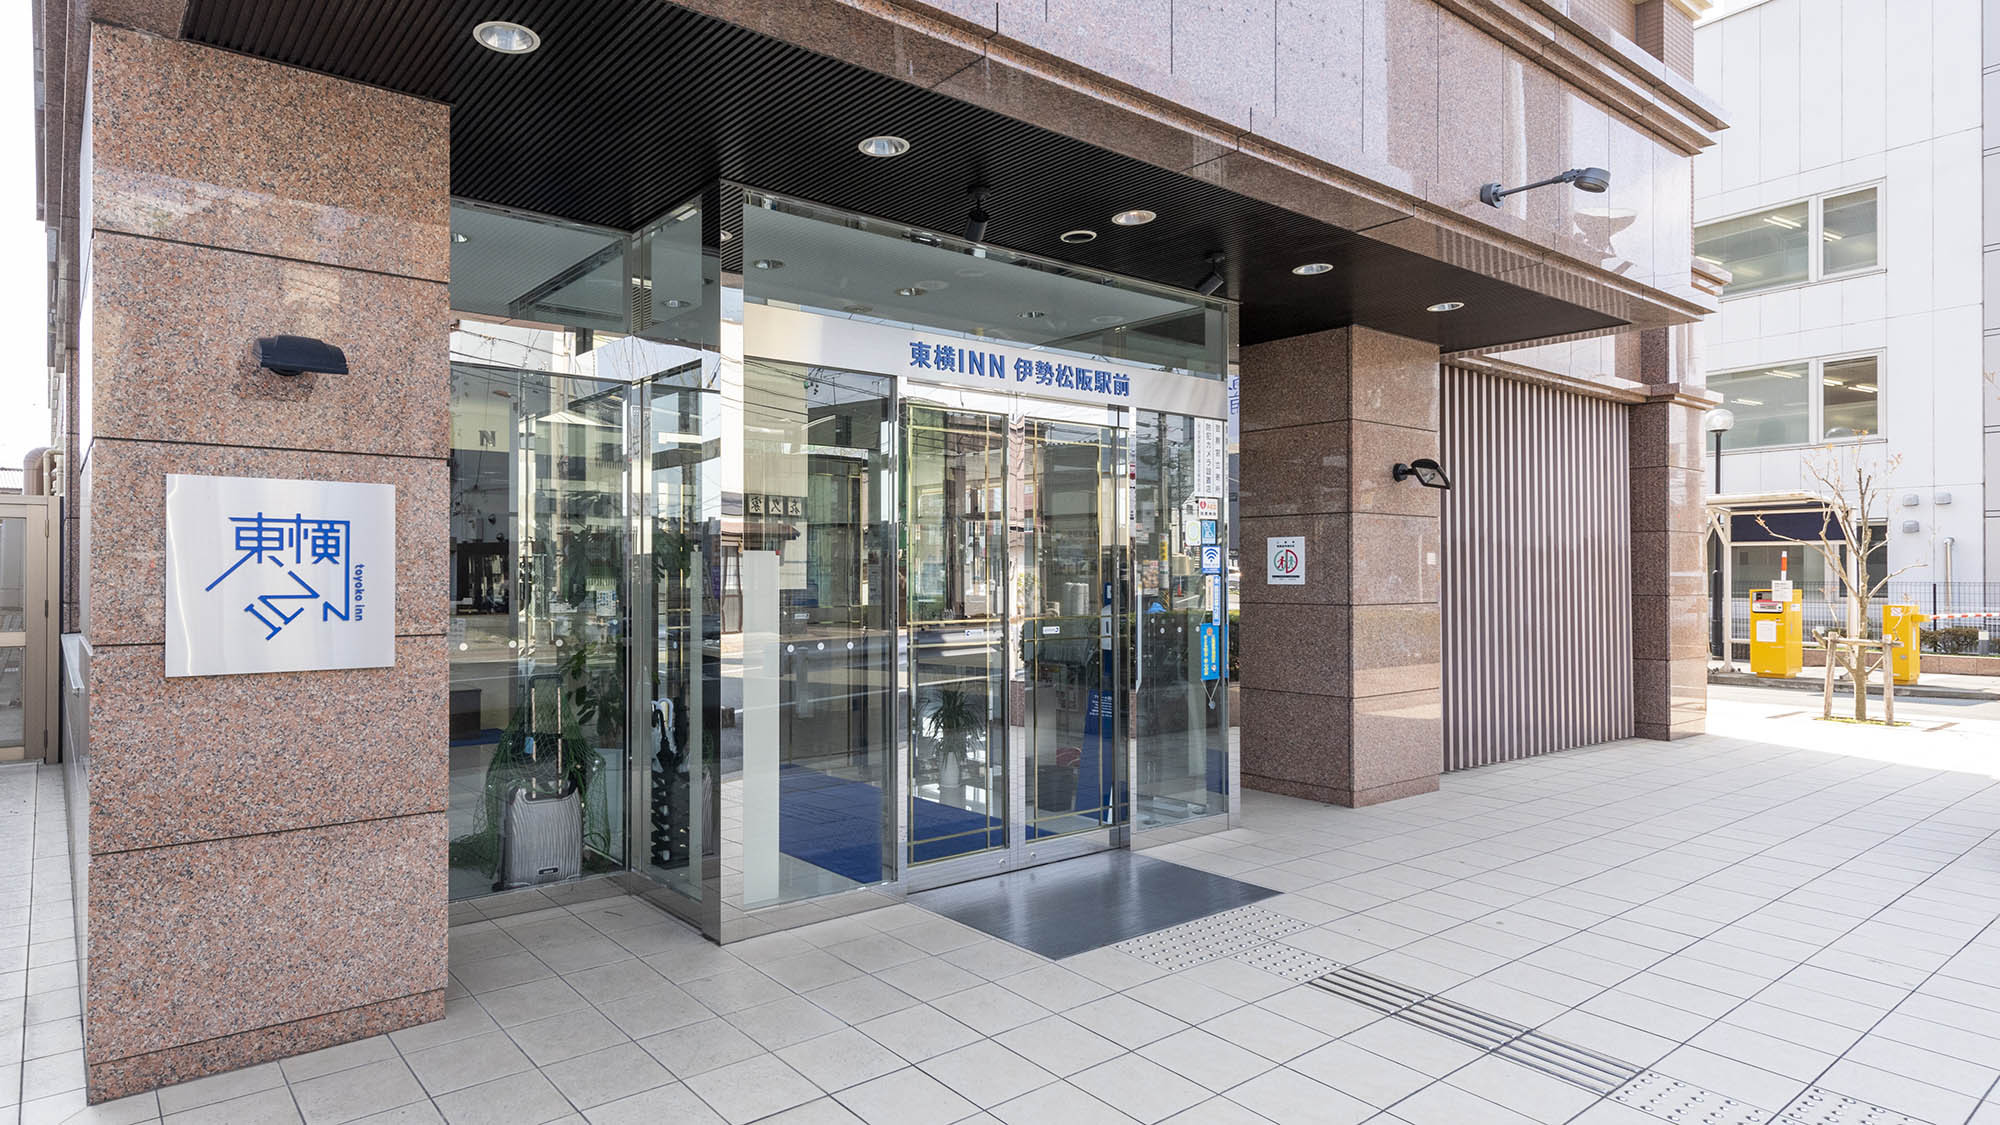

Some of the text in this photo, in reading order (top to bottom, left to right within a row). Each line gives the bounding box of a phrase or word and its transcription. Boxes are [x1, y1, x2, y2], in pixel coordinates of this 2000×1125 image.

[909, 341, 1131, 397] 東横INN 伊勢松阪駅前
[353, 563, 366, 621] toyoko inn
